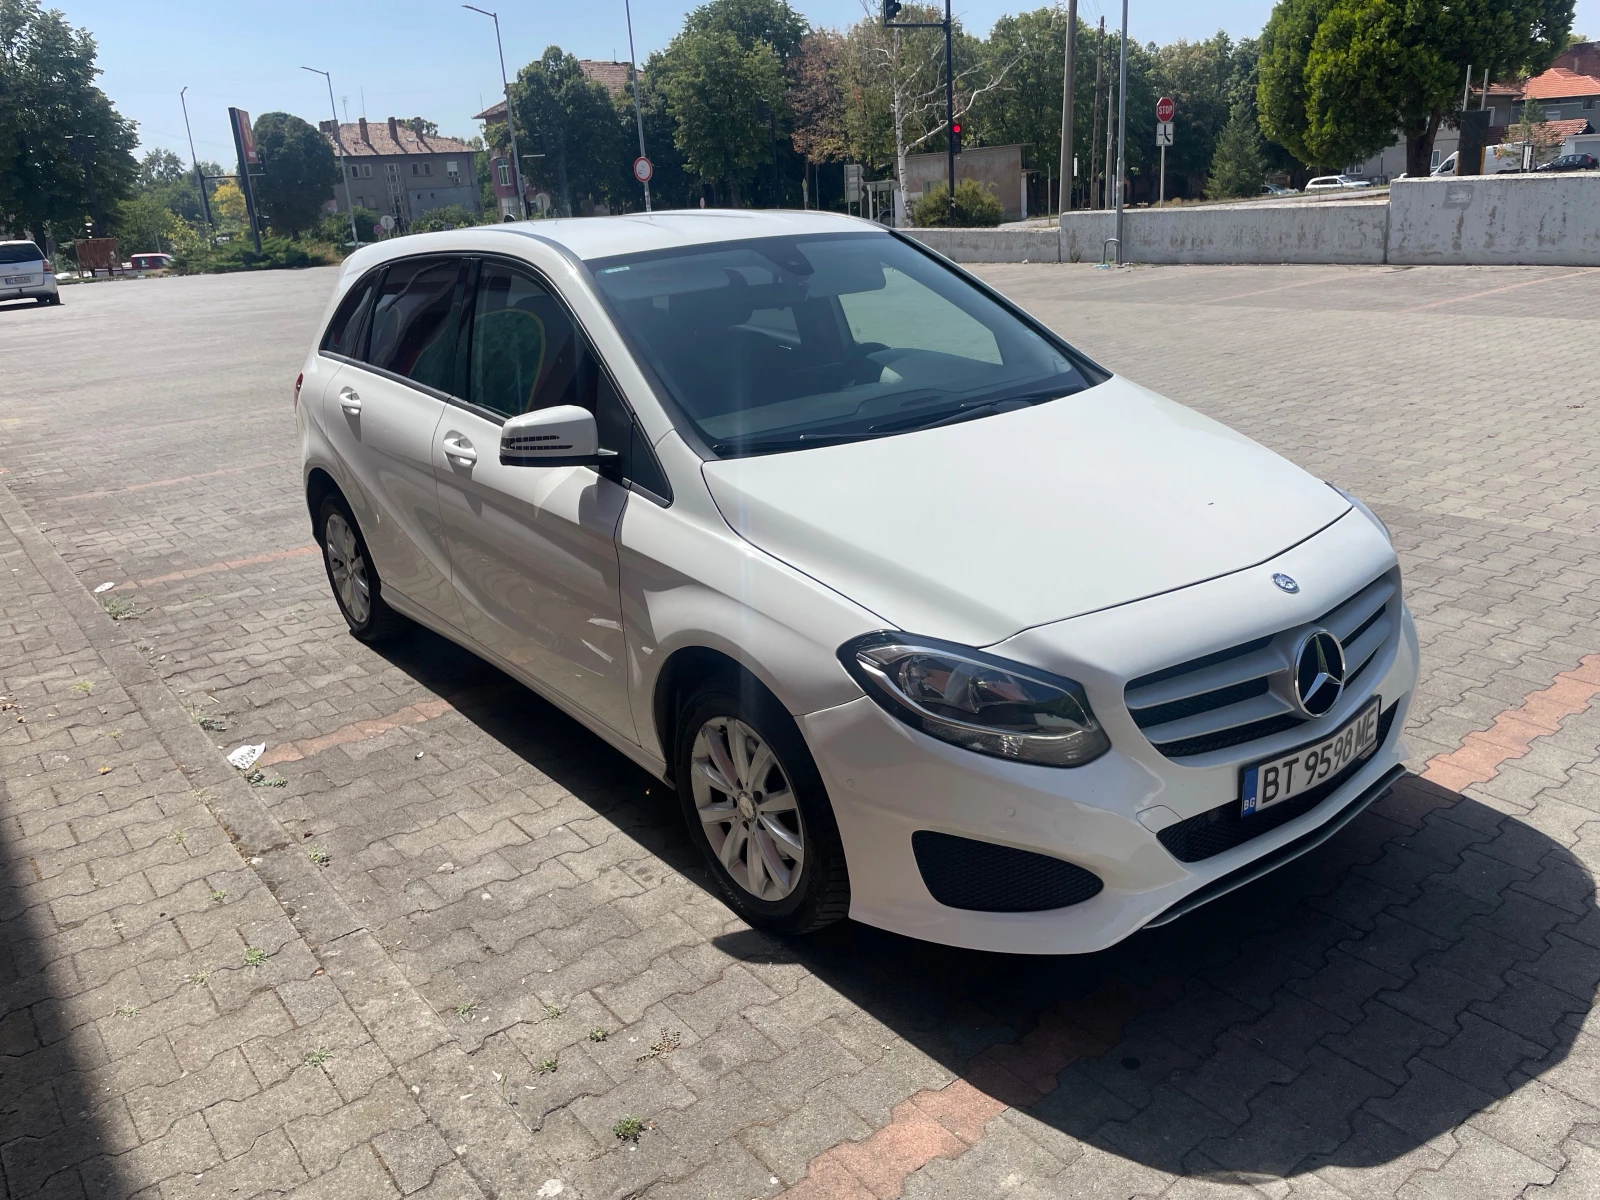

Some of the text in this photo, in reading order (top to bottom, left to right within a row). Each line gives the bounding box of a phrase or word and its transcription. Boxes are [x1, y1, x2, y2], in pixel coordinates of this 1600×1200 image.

[1158, 105, 1173, 115] STOP
[1262, 708, 1376, 804] BT 9598 ME
[1243, 797, 1255, 811] BG
